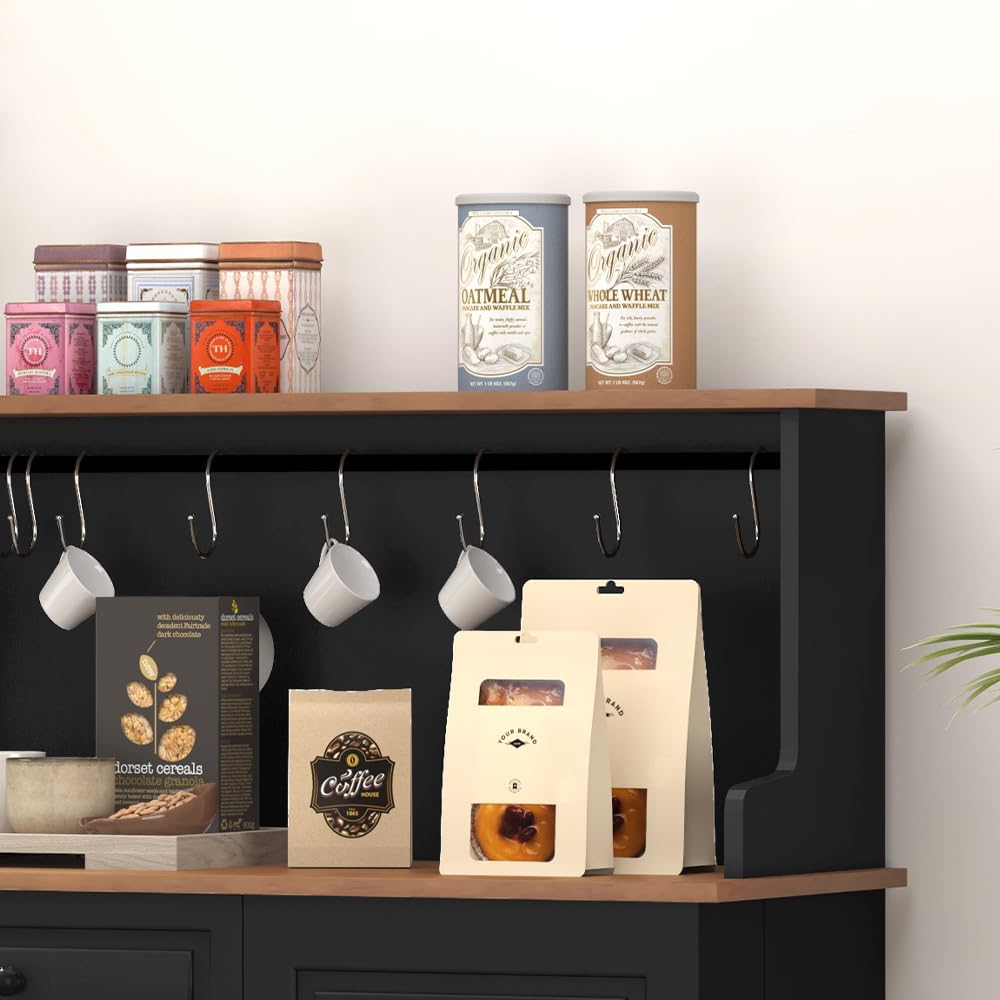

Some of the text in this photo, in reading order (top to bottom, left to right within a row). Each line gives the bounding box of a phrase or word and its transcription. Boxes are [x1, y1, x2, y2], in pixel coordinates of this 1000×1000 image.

[461, 230, 529, 285] Organic
[588, 227, 658, 284] Organic
[461, 288, 531, 304] OATMEAL
[587, 289, 668, 303] WHOLE WHEAT
[605, 697, 624, 716] RAND
[498, 728, 537, 744] YOUR BRAND
[156, 762, 204, 775] cereals
[321, 769, 385, 797] Coffee
